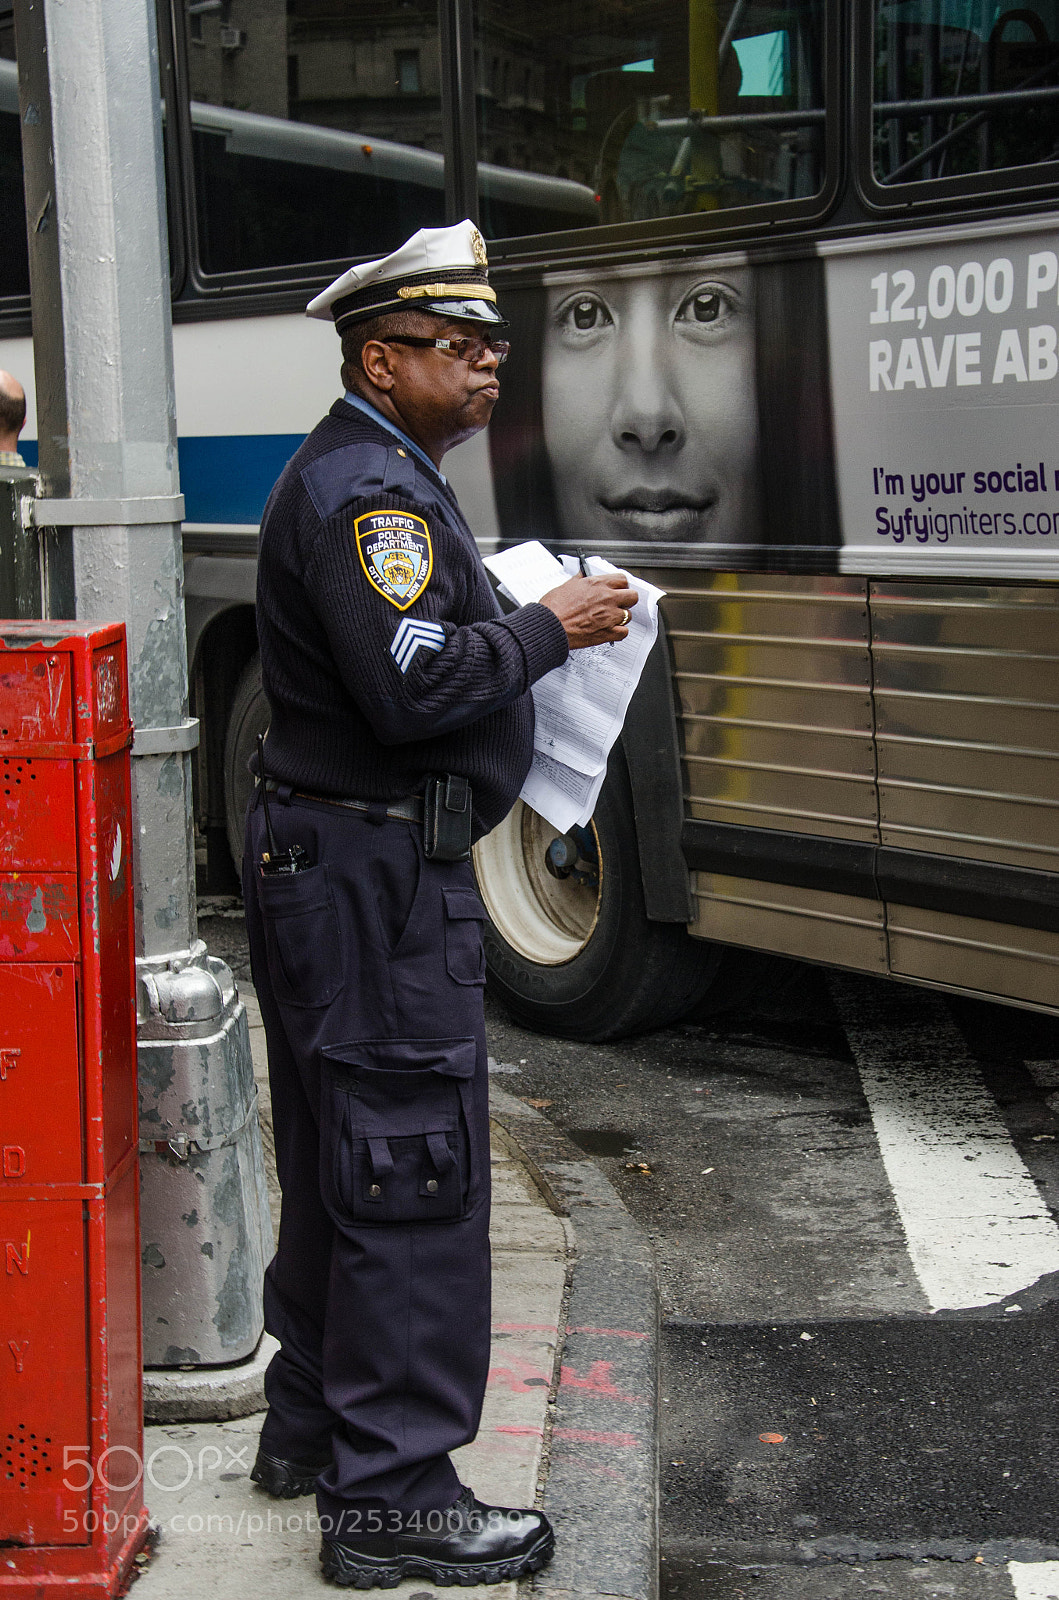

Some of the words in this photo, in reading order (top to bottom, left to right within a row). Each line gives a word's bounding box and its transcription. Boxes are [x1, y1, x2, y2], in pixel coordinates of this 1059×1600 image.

[869, 258, 1014, 329] 12,000
[1026, 251, 1059, 309] P
[869, 332, 981, 391] RAVE
[992, 325, 1059, 384] AB
[873, 467, 904, 495] I'm
[911, 472, 966, 502] your
[973, 462, 1047, 494] social
[370, 516, 415, 529] TRAFFIC
[378, 531, 412, 542] POLICE
[366, 540, 424, 555] DEPARTMENT
[368, 565, 384, 584] CITY
[382, 583, 395, 596] OF
[406, 581, 421, 599] NEW
[417, 559, 429, 581] YORK
